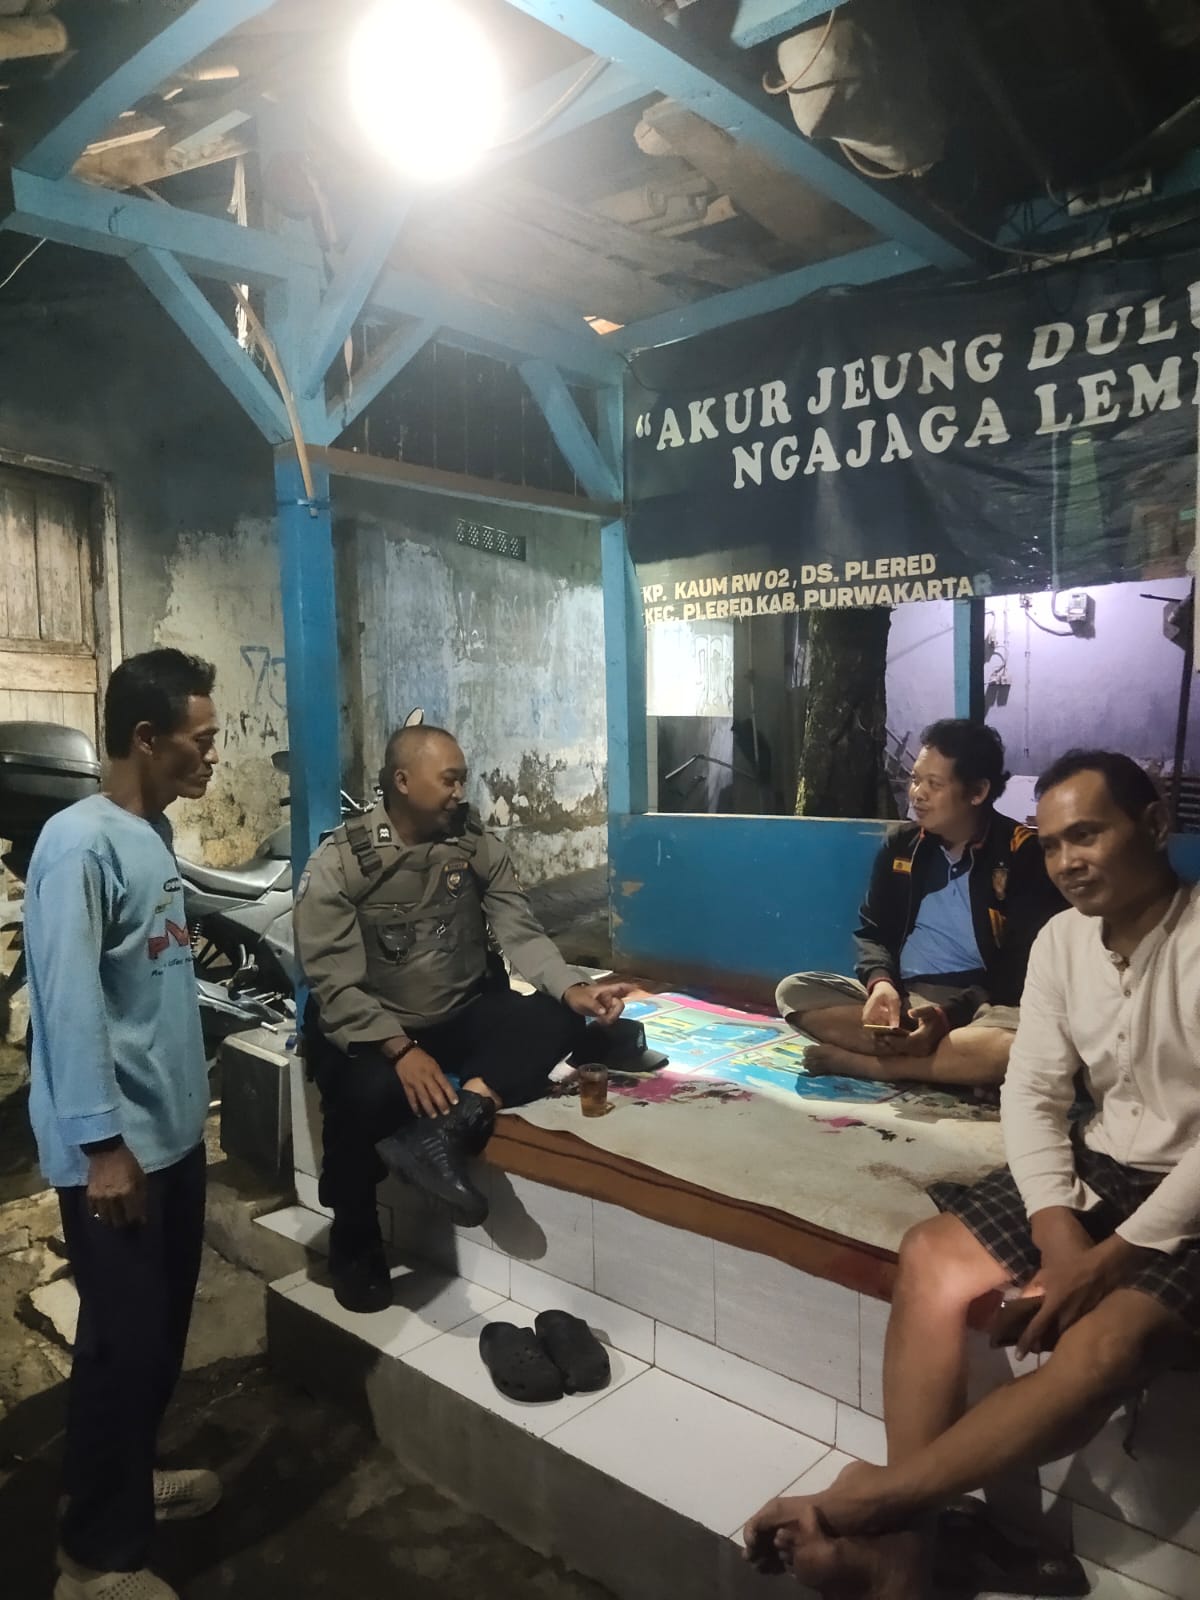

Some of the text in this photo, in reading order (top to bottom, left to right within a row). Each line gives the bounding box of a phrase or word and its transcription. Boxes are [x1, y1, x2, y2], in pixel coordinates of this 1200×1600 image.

[807, 333, 1004, 415] JEUNG
[732, 351, 1200, 489] NGAJAGA LEM
[674, 576, 728, 600] KAUM
[731, 572, 762, 594] RW
[801, 563, 839, 585] DS.
[845, 553, 937, 582] PLERED
[683, 596, 753, 622] PLERED
